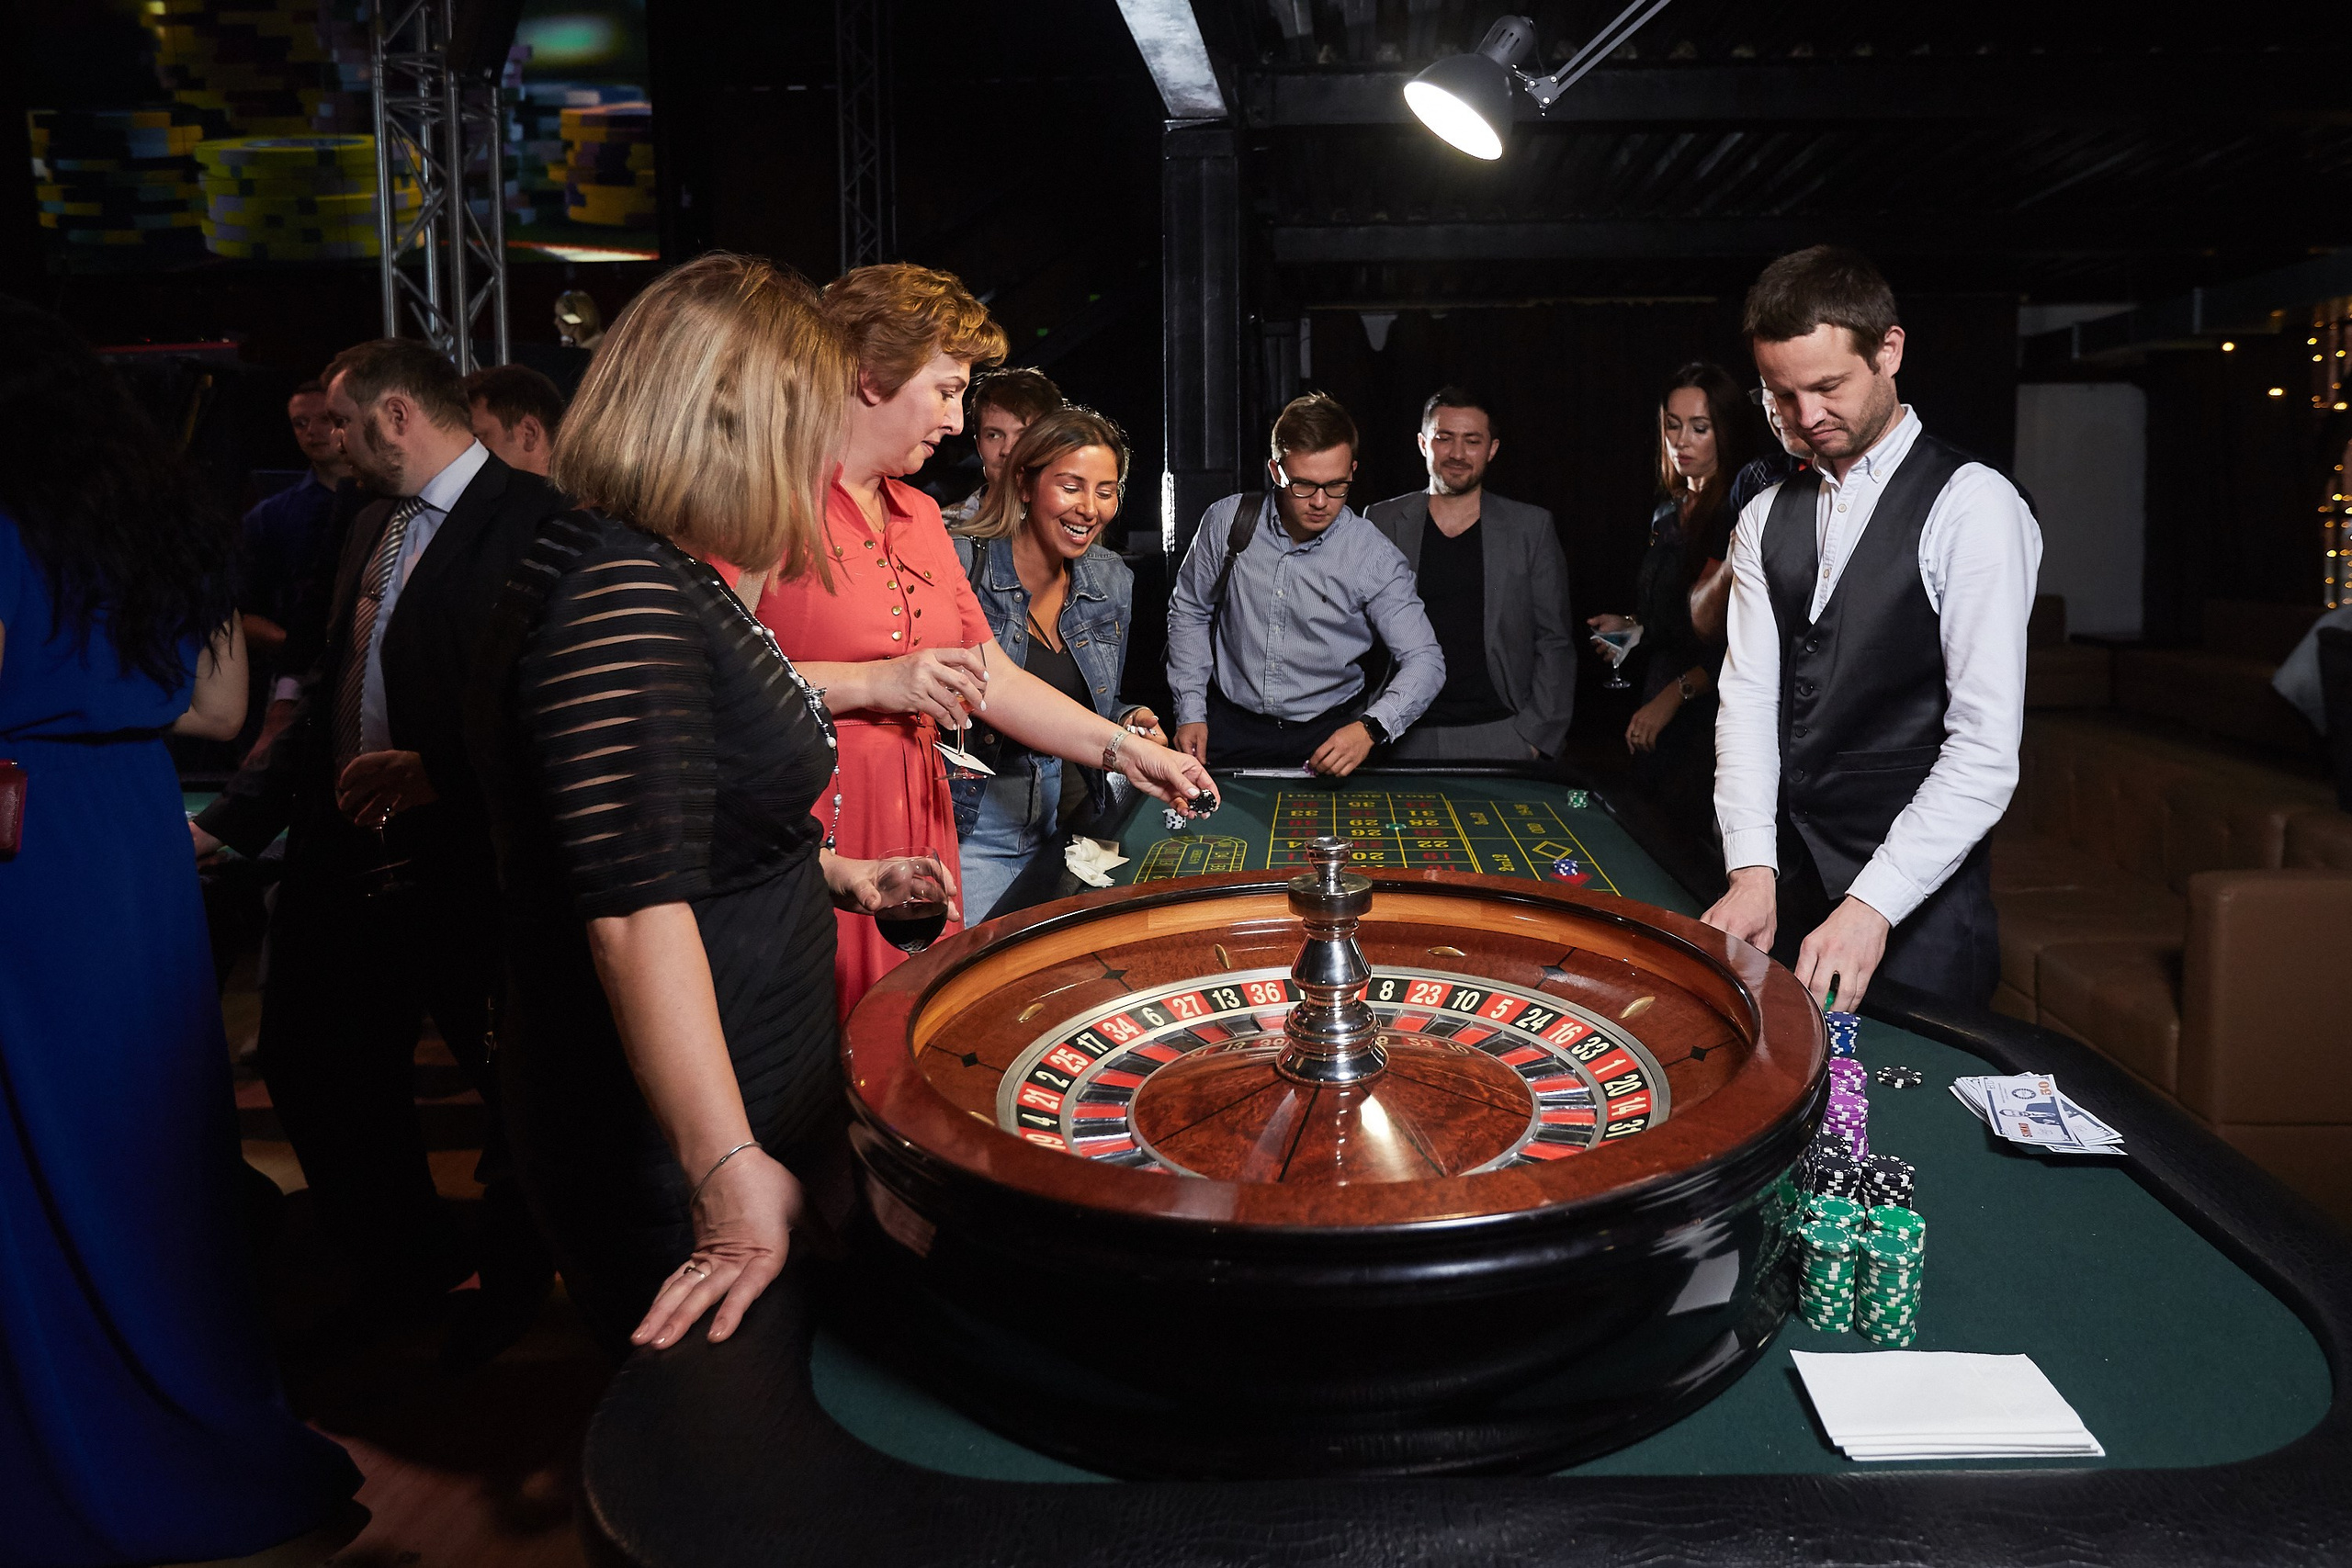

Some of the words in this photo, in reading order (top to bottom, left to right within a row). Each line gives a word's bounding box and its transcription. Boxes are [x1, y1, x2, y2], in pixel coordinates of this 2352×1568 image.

[1212, 988, 1240, 1010] 13
[1250, 983, 1282, 1004] 36
[1379, 980, 1395, 1000] 8
[1410, 984, 1442, 1005] 23
[1452, 990, 1480, 1011] 10
[1141, 1007, 1165, 1027] 6
[1172, 996, 1203, 1018] 27
[1490, 999, 1514, 1019] 5
[1102, 1018, 1140, 1041] 34
[1515, 1009, 1554, 1032] 24
[1077, 1032, 1109, 1055] 17
[1548, 1022, 1583, 1044] 16
[1572, 1037, 1610, 1060] 33
[1050, 1048, 1089, 1074] 25
[1595, 1059, 1626, 1075] 1
[1035, 1070, 1069, 1089] 2
[1604, 1075, 1642, 1096] 20
[2038, 1081, 2052, 1096] 50
[1022, 1089, 1060, 1110] 21
[1611, 1097, 1646, 1116] 14
[1022, 1113, 1057, 1126] 4
